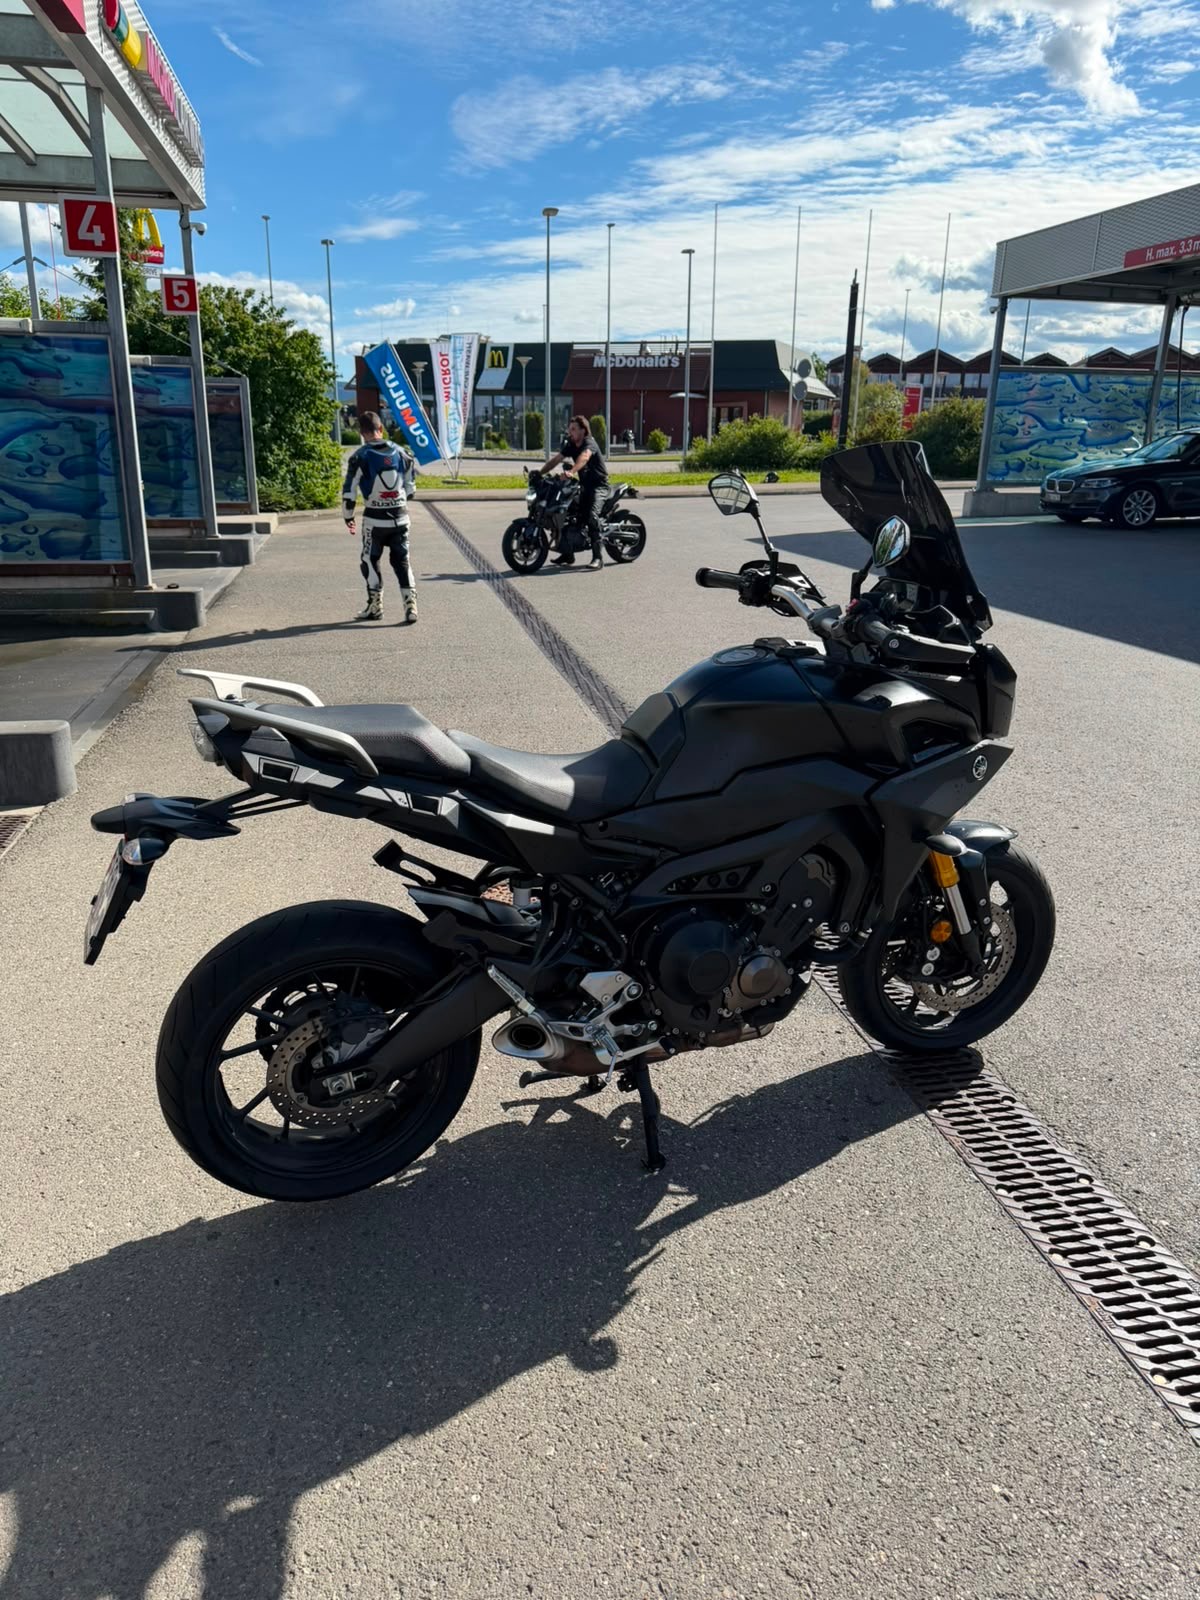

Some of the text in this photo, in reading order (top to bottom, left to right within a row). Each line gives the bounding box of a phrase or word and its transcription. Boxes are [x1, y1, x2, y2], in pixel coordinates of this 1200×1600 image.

[78, 205, 105, 246] 4
[1145, 248, 1154, 261] H.
[1156, 246, 1177, 259] max.
[1179, 239, 1193, 254] 3.3
[172, 280, 190, 308] 5
[593, 355, 680, 368] McDonald's
